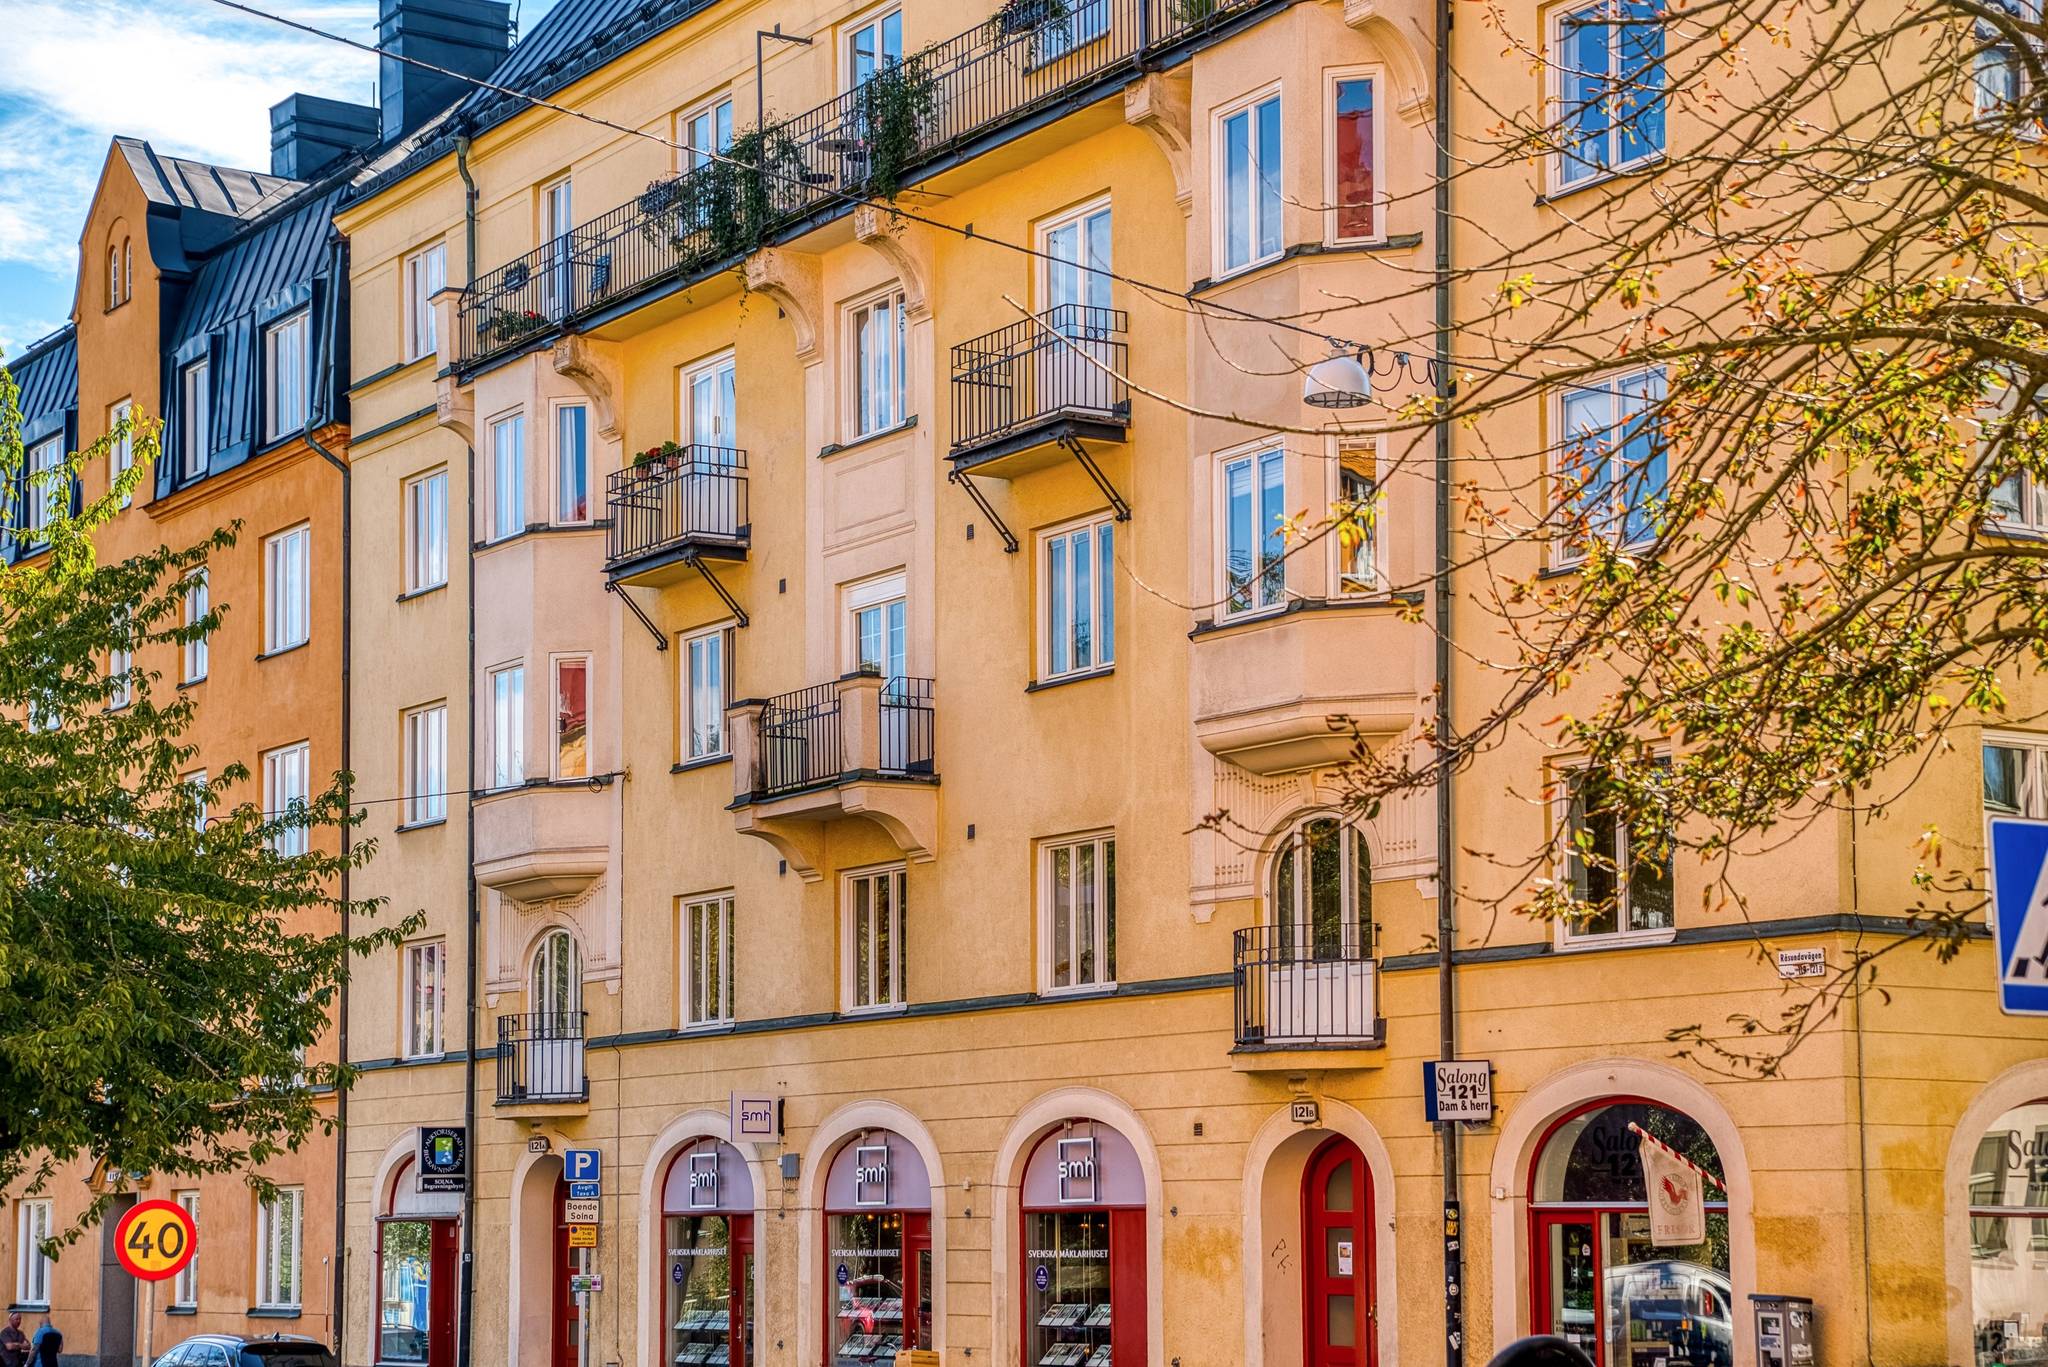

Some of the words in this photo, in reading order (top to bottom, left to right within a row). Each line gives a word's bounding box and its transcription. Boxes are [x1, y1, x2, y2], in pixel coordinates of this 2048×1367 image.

[1437, 1067, 1487, 1093] Salong
[1449, 1085, 1477, 1099] 121
[1440, 1101, 1458, 1111] Dam
[1461, 1100, 1467, 1111] &
[1470, 1100, 1489, 1111] herr
[741, 1110, 771, 1121] smh
[1592, 1126, 1638, 1164] Salo
[575, 1153, 592, 1178] P
[856, 1162, 887, 1183] smh
[1058, 1155, 1094, 1178] smh
[1608, 1154, 1636, 1176] 12
[690, 1168, 717, 1187] smh
[567, 1203, 597, 1211] Boende
[128, 1221, 184, 1259] 40
[668, 1248, 690, 1256] SVENSKA
[691, 1247, 727, 1256] MÄKLARHUSET
[831, 1249, 856, 1257] SVENSKA
[857, 1248, 899, 1257] MÄKLARHUSET
[1028, 1249, 1058, 1258] SVENSKA
[1059, 1248, 1108, 1258] MÄKLARHUSET
